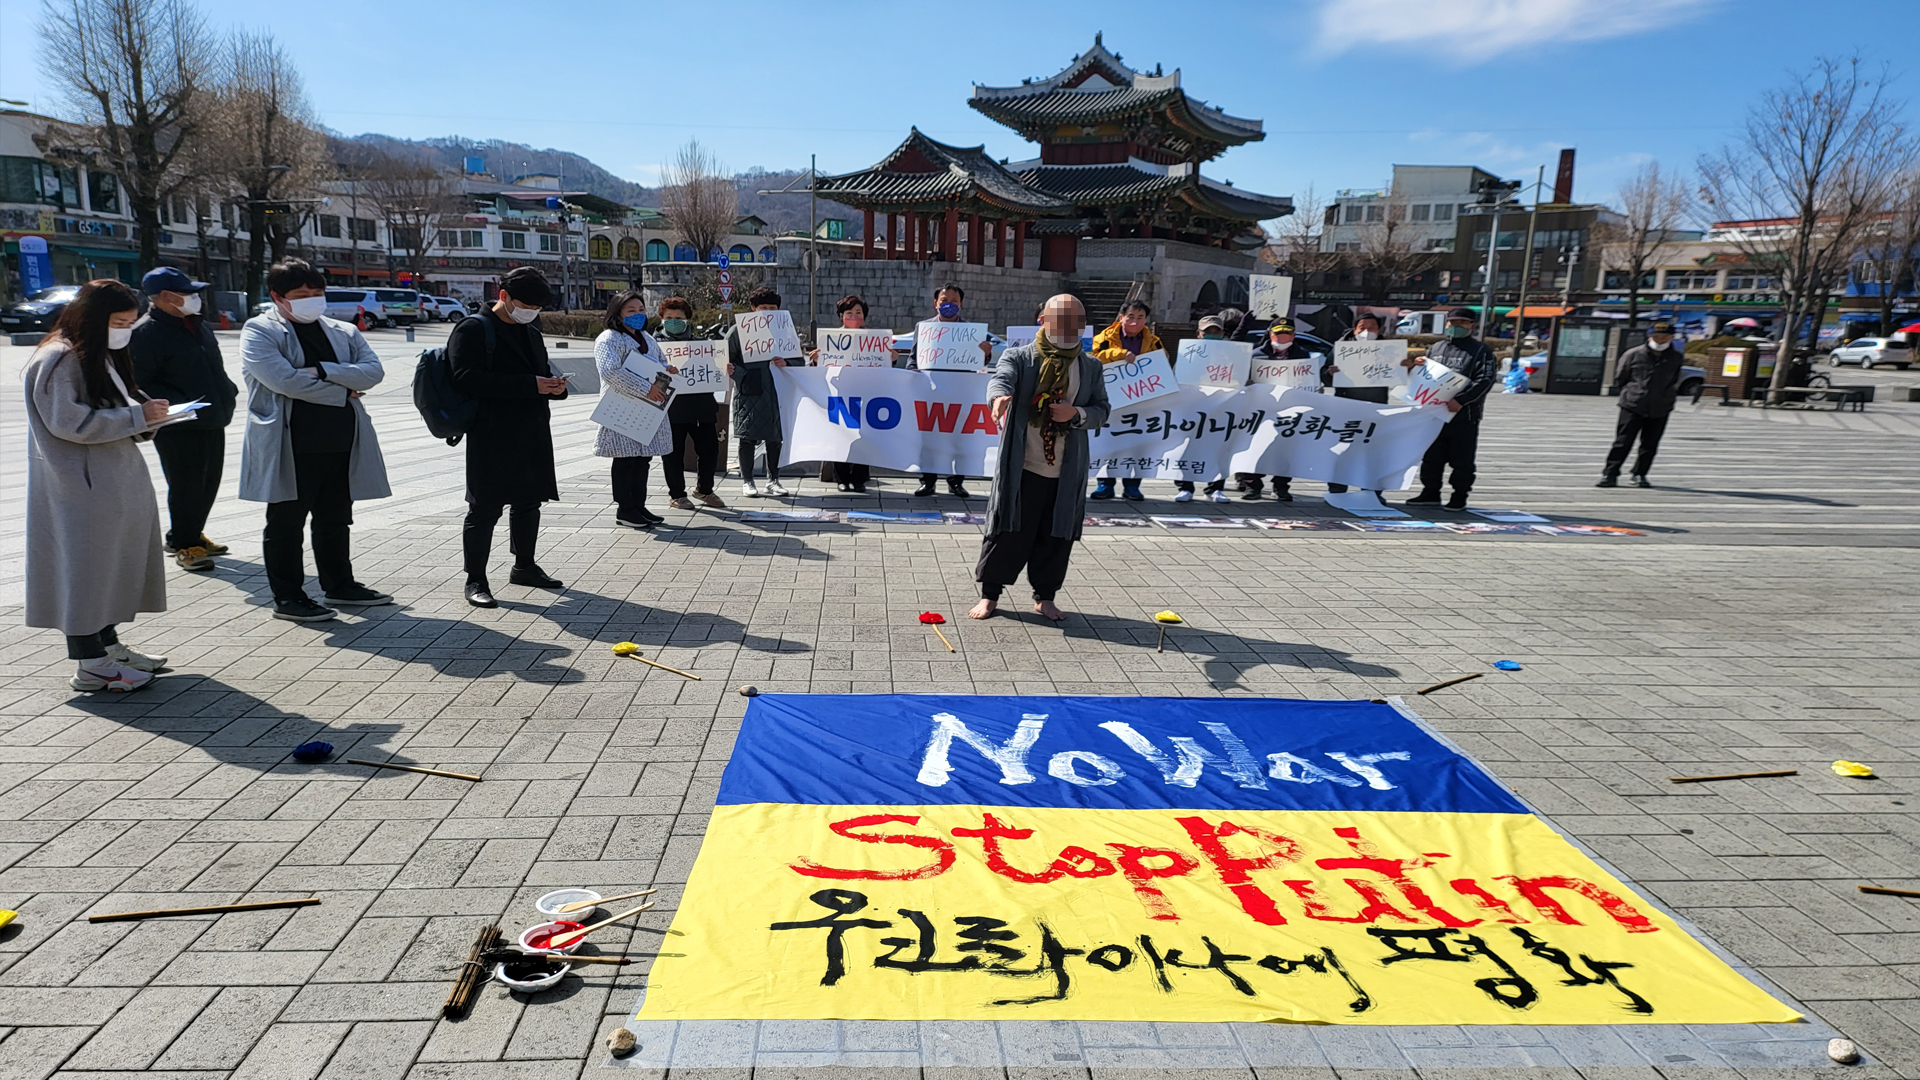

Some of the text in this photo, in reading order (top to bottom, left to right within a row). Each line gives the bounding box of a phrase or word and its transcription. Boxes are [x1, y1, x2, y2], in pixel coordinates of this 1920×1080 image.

[79, 220, 102, 234] GS25
[741, 314, 774, 333] STOP
[826, 333, 892, 352] NO WAR
[920, 326, 979, 343] STOP WAR
[664, 345, 725, 361] 우크라이나에
[745, 338, 775, 357] STOP
[851, 353, 884, 361] Ukraine
[919, 349, 979, 365] STOP Putin
[1183, 344, 1208, 363] 푸틴
[680, 364, 722, 386] 평화를
[1103, 357, 1152, 384] STOP
[1206, 363, 1234, 384] 멈춰
[1256, 365, 1315, 378] STOP WAR
[1120, 374, 1165, 400] WAR
[827, 396, 1000, 436] NO WA
[1274, 412, 1377, 444] 평화를!
[915, 712, 1411, 792] No War
[789, 812, 1201, 924] Stop
[1366, 926, 1656, 1015] 평화
